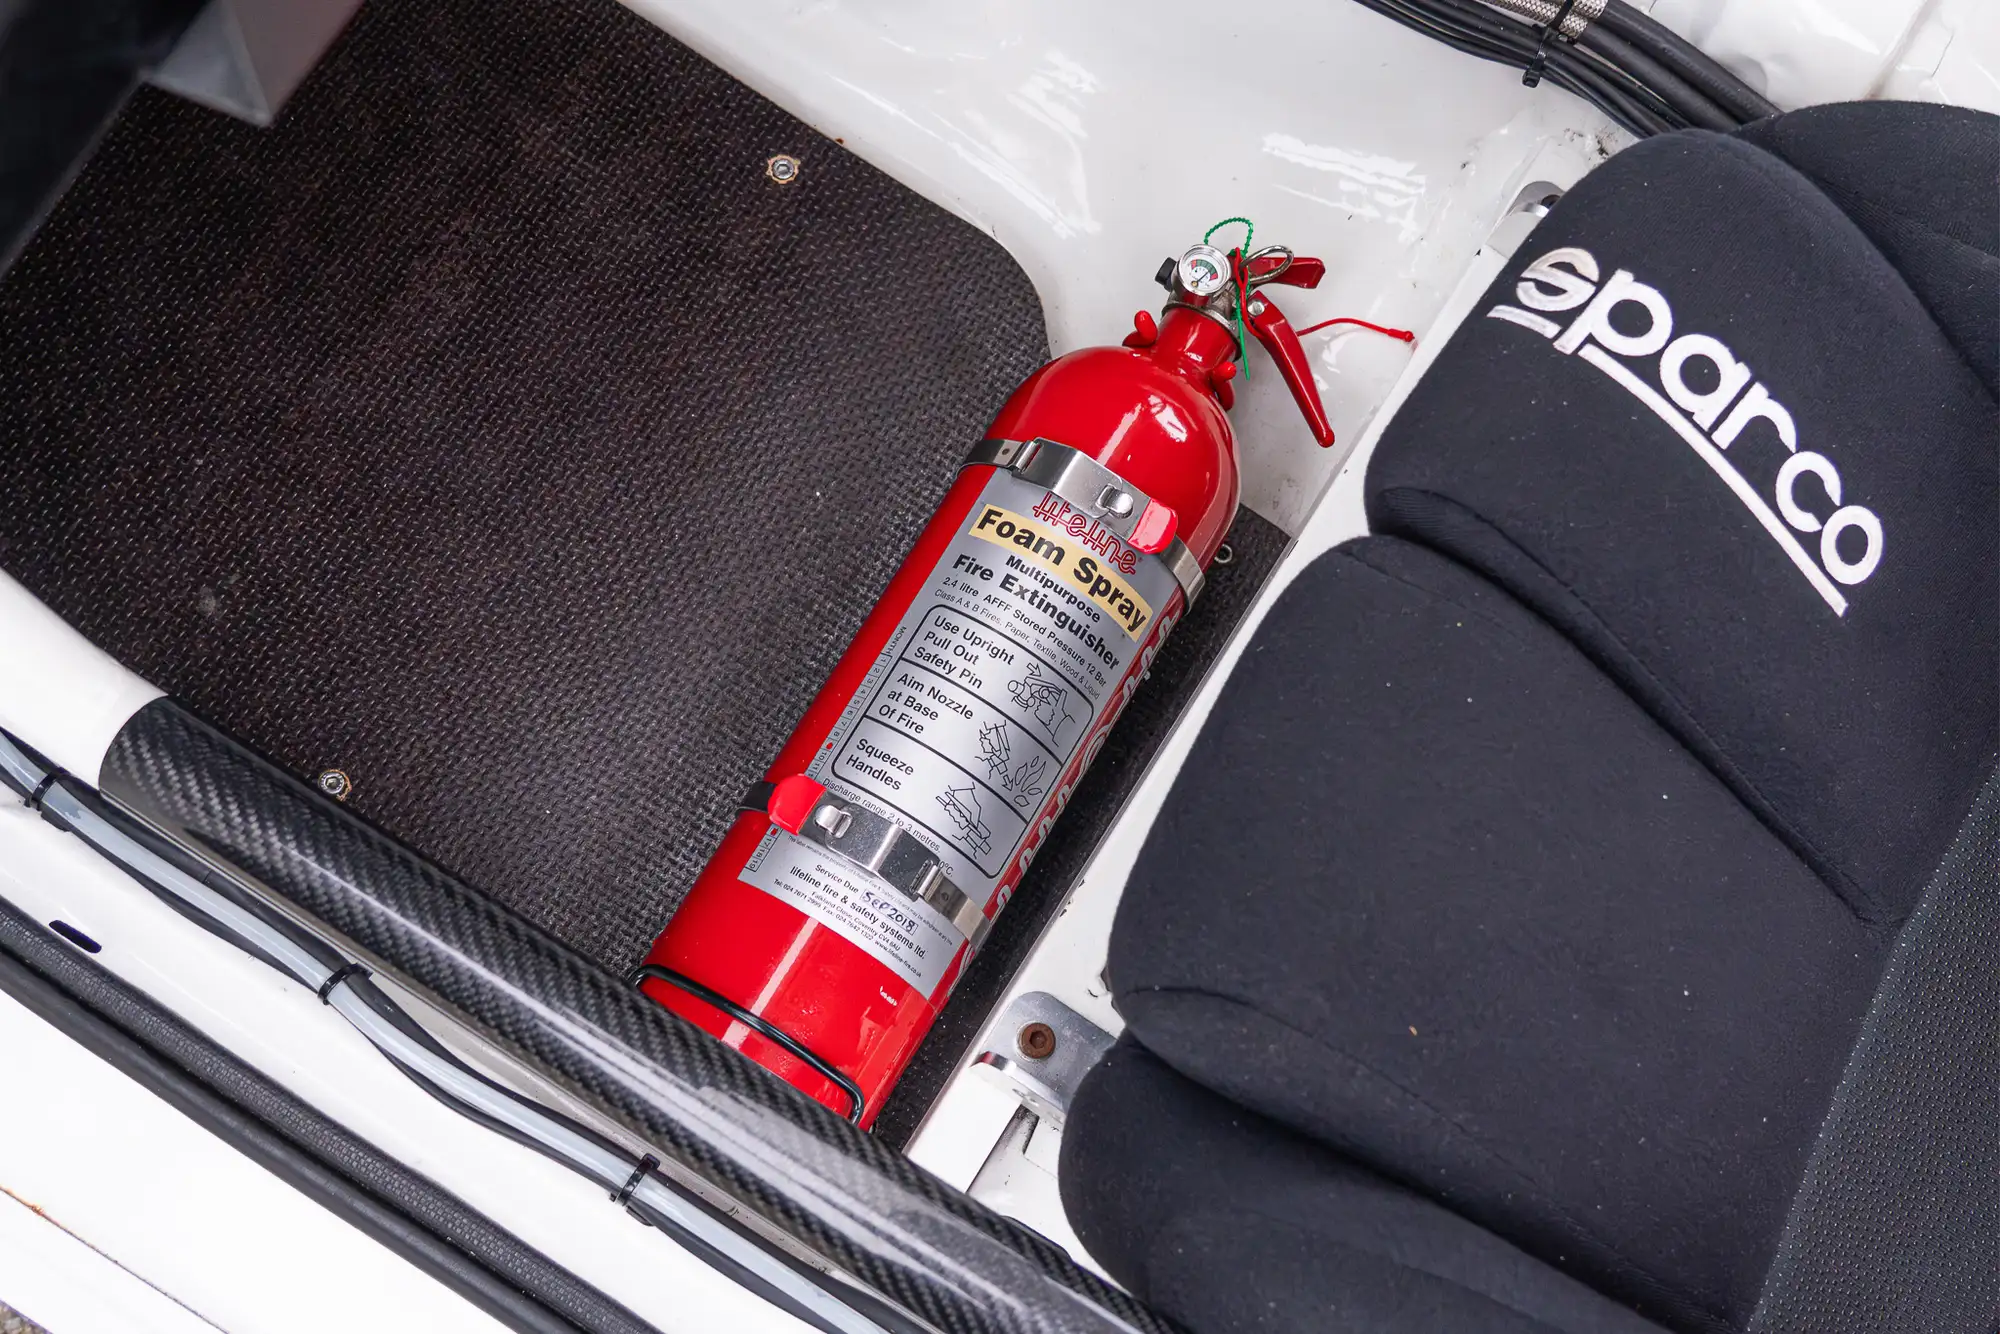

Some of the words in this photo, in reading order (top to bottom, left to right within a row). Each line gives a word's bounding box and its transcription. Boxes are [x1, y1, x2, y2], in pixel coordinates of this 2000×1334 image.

[1516, 248, 1884, 586] sparco
[976, 508, 1065, 566] Foam
[1073, 556, 1146, 632] Spray
[1005, 554, 1100, 623] Multipurpose
[952, 553, 994, 581] Fire
[998, 572, 1119, 669] Extinguisher
[885, 625, 907, 654] MONTH
[923, 630, 952, 650] Pull
[952, 644, 979, 665] Out
[934, 588, 956, 602] Class
[955, 597, 963, 605] A
[963, 600, 970, 608] &
[971, 603, 980, 612] B
[1059, 657, 1080, 678] Wood
[1078, 675, 1085, 684] &
[934, 614, 959, 634] Use
[962, 628, 1014, 665] Upright
[942, 576, 958, 588] 2.4
[959, 582, 979, 597] litre
[982, 594, 1012, 611] AFFF
[1012, 609, 1047, 635] Stored
[1046, 630, 1085, 666] Pressure
[1085, 662, 1096, 675] 12
[1094, 670, 1106, 687] Bar
[914, 646, 957, 675] Safety
[958, 667, 982, 689] Pin
[887, 690, 902, 702] at
[903, 694, 938, 720] Base
[896, 673, 924, 693] Aim
[926, 685, 973, 719] Nozzle
[878, 704, 897, 719] Of
[896, 712, 924, 734] Fire
[812, 762, 820, 770] 11
[818, 751, 827, 760] 10
[845, 754, 901, 790] Handles
[856, 738, 914, 775] Squeeze
[822, 777, 861, 802] Discharge
[861, 799, 886, 816] range
[886, 812, 895, 821] 2
[894, 817, 904, 827] to
[905, 823, 913, 832] 3
[912, 829, 942, 855] metres.
[755, 848, 765, 858] 18
[764, 838, 772, 847] 17
[748, 859, 758, 870] 19
[814, 864, 842, 883] Service
[843, 880, 859, 893] Due
[782, 883, 794, 892] 024
[835, 913, 846, 923] 024
[789, 865, 821, 888] lifeline
[822, 883, 839, 898] fire
[840, 894, 848, 904] &
[849, 902, 879, 924] safety
[879, 921, 914, 949] systems
[913, 944, 926, 959] ltd.
[886, 907, 916, 934] 2018
